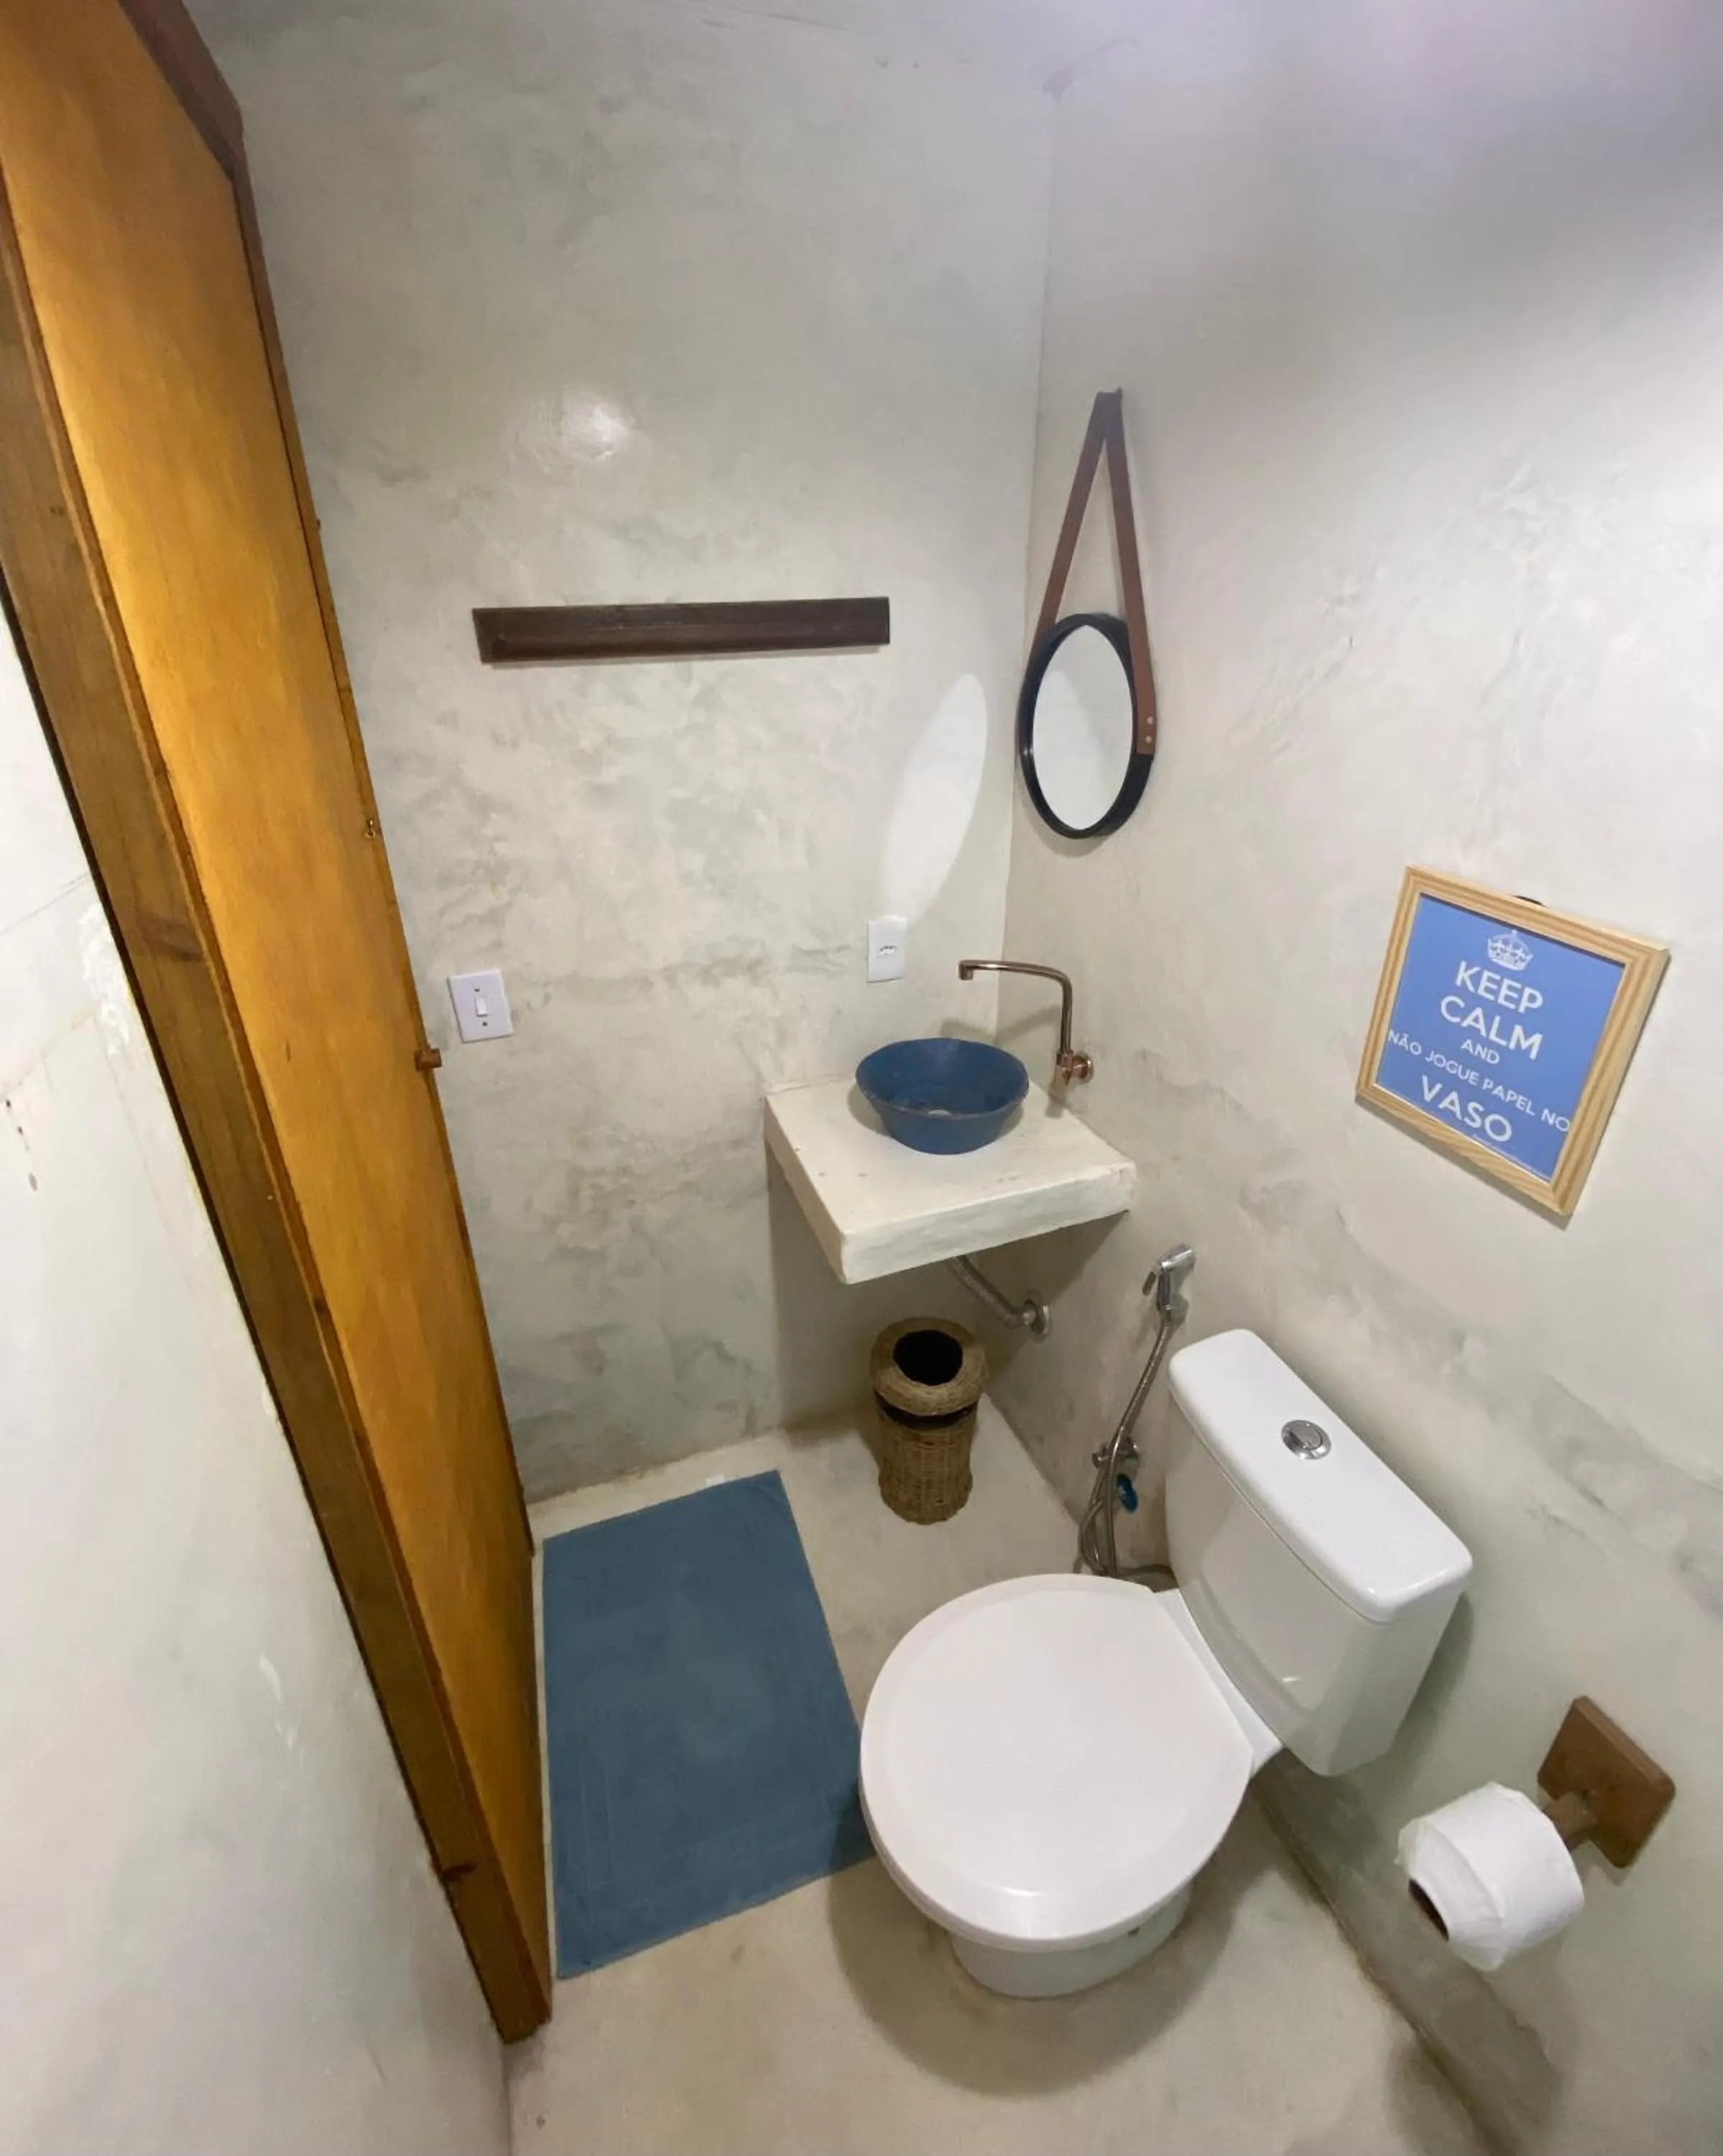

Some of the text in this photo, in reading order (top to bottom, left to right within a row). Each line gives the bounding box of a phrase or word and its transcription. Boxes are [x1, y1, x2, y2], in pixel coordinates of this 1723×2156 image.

[1455, 960, 1542, 1013] KEEP
[1441, 995, 1543, 1060] CALM
[1460, 1038, 1500, 1064] AND
[1387, 1029, 1571, 1133] NÃO JOGUE PAPEL NO
[1421, 1074, 1512, 1142] VASO
